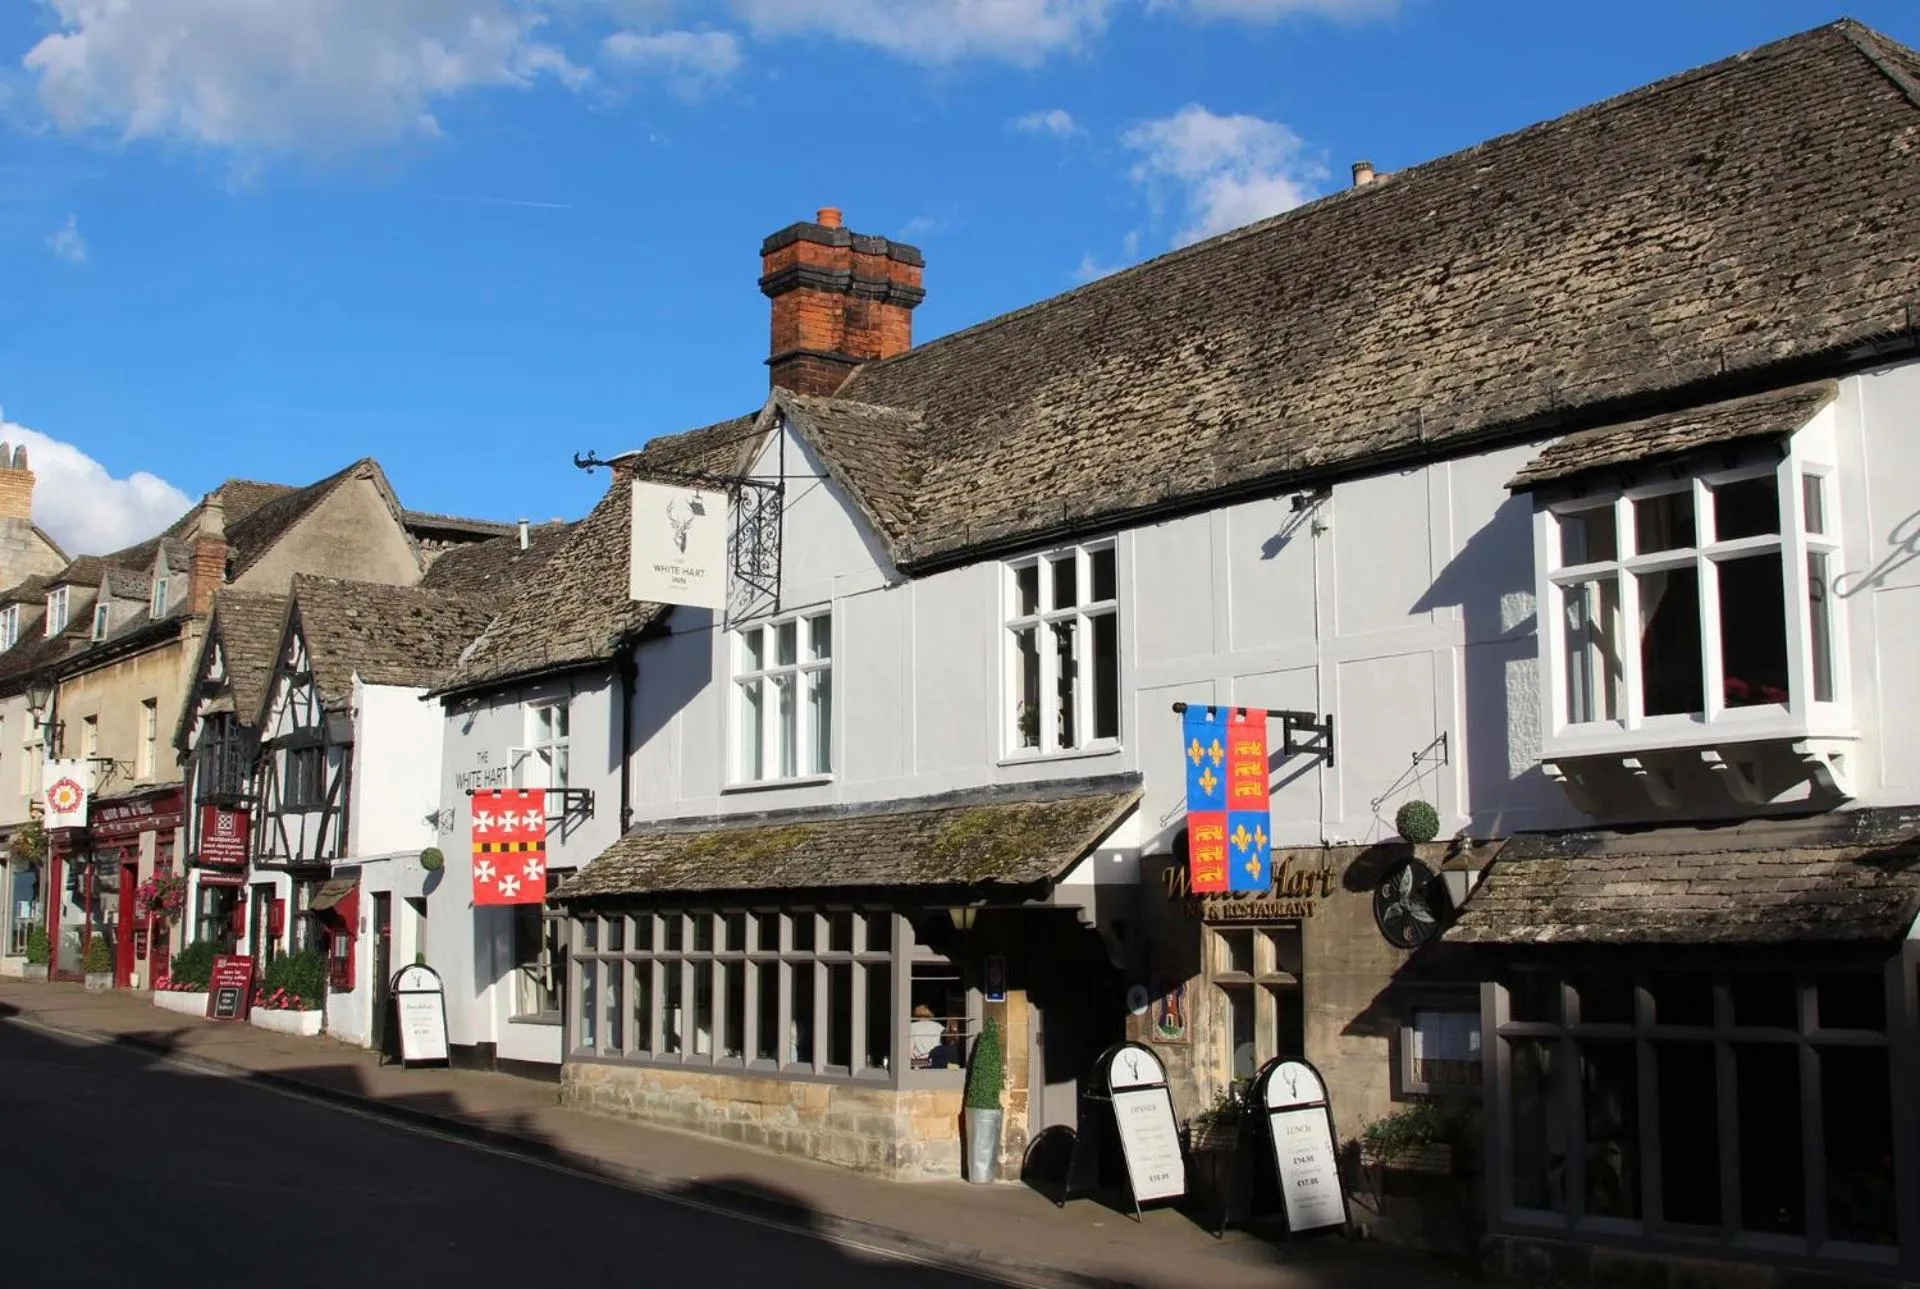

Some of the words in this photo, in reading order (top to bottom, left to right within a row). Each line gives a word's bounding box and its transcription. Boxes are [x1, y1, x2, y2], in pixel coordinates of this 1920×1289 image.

[653, 563, 680, 575] WHITE
[683, 567, 705, 578] HART
[671, 576, 686, 584] INN
[476, 750, 488, 764] THE
[456, 769, 482, 789] WHITE
[485, 766, 507, 787] HART
[1223, 900, 1316, 918] RESTAURANT
[1130, 1103, 1157, 1114] DINNER
[1286, 1124, 1312, 1135] LUNCH
